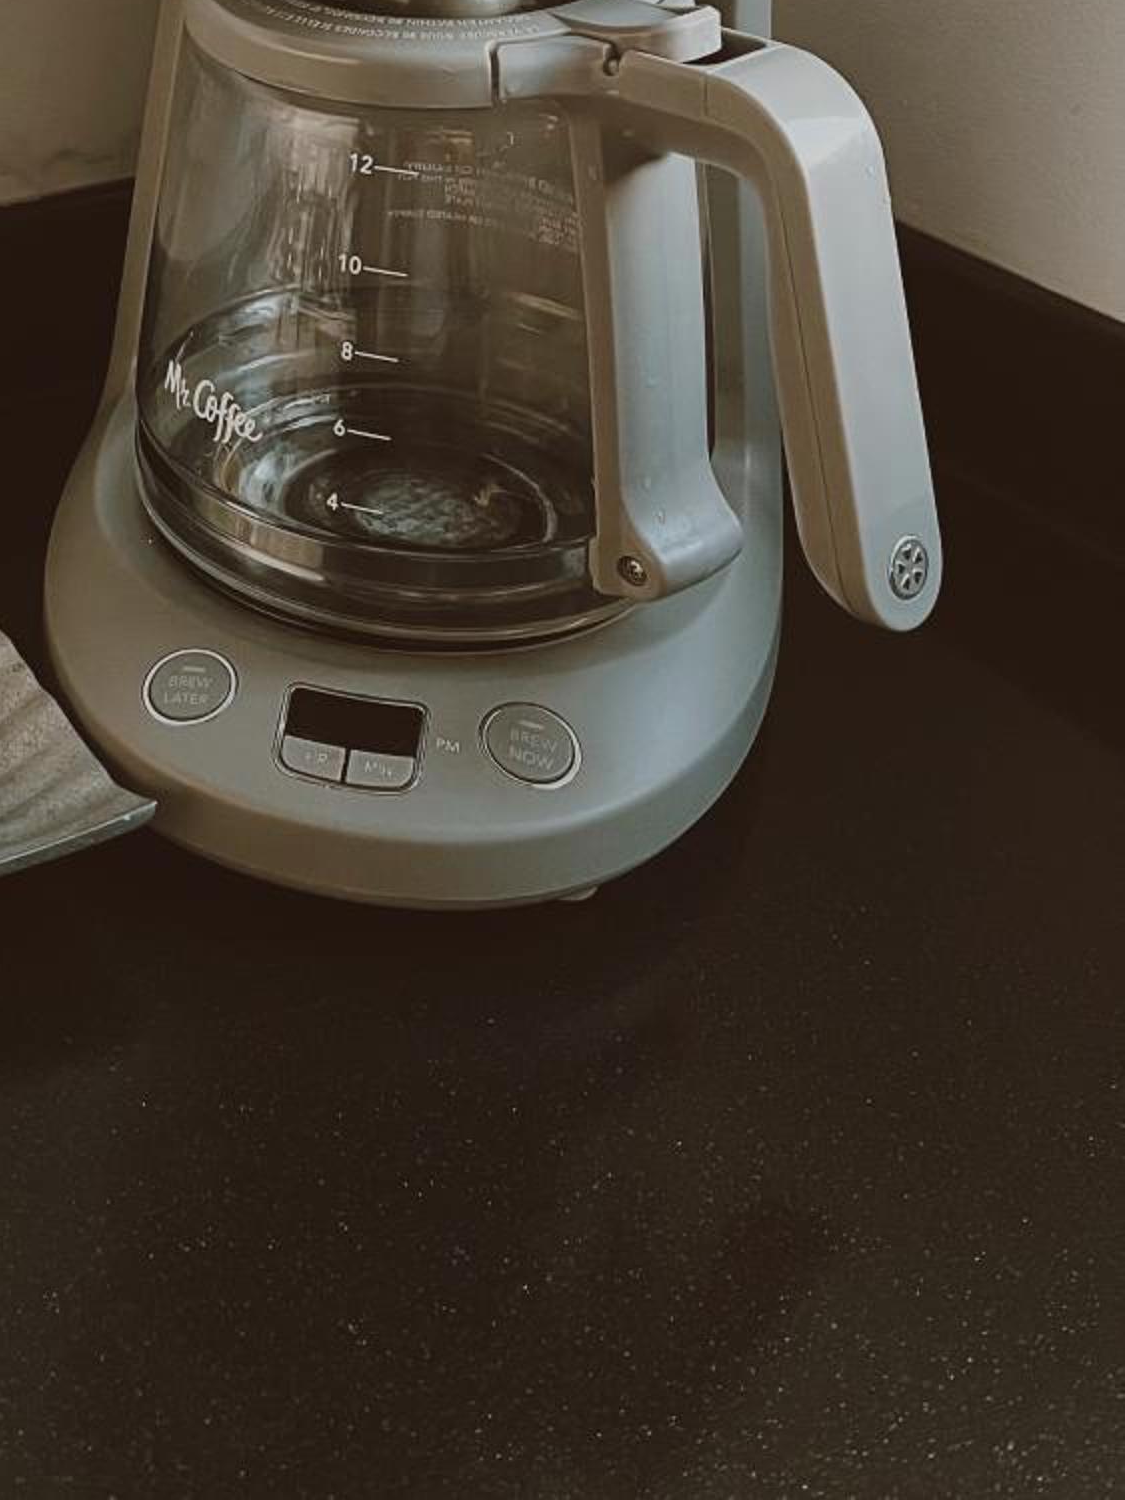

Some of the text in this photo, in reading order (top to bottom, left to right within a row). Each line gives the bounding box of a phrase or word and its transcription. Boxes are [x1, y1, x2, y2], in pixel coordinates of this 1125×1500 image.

[350, 152, 374, 175] 12
[338, 253, 362, 275] 10
[341, 341, 354, 361] 8
[193, 379, 264, 444] Coffee
[333, 419, 347, 437] 6
[326, 491, 339, 511] 4
[435, 736, 460, 753] PM
